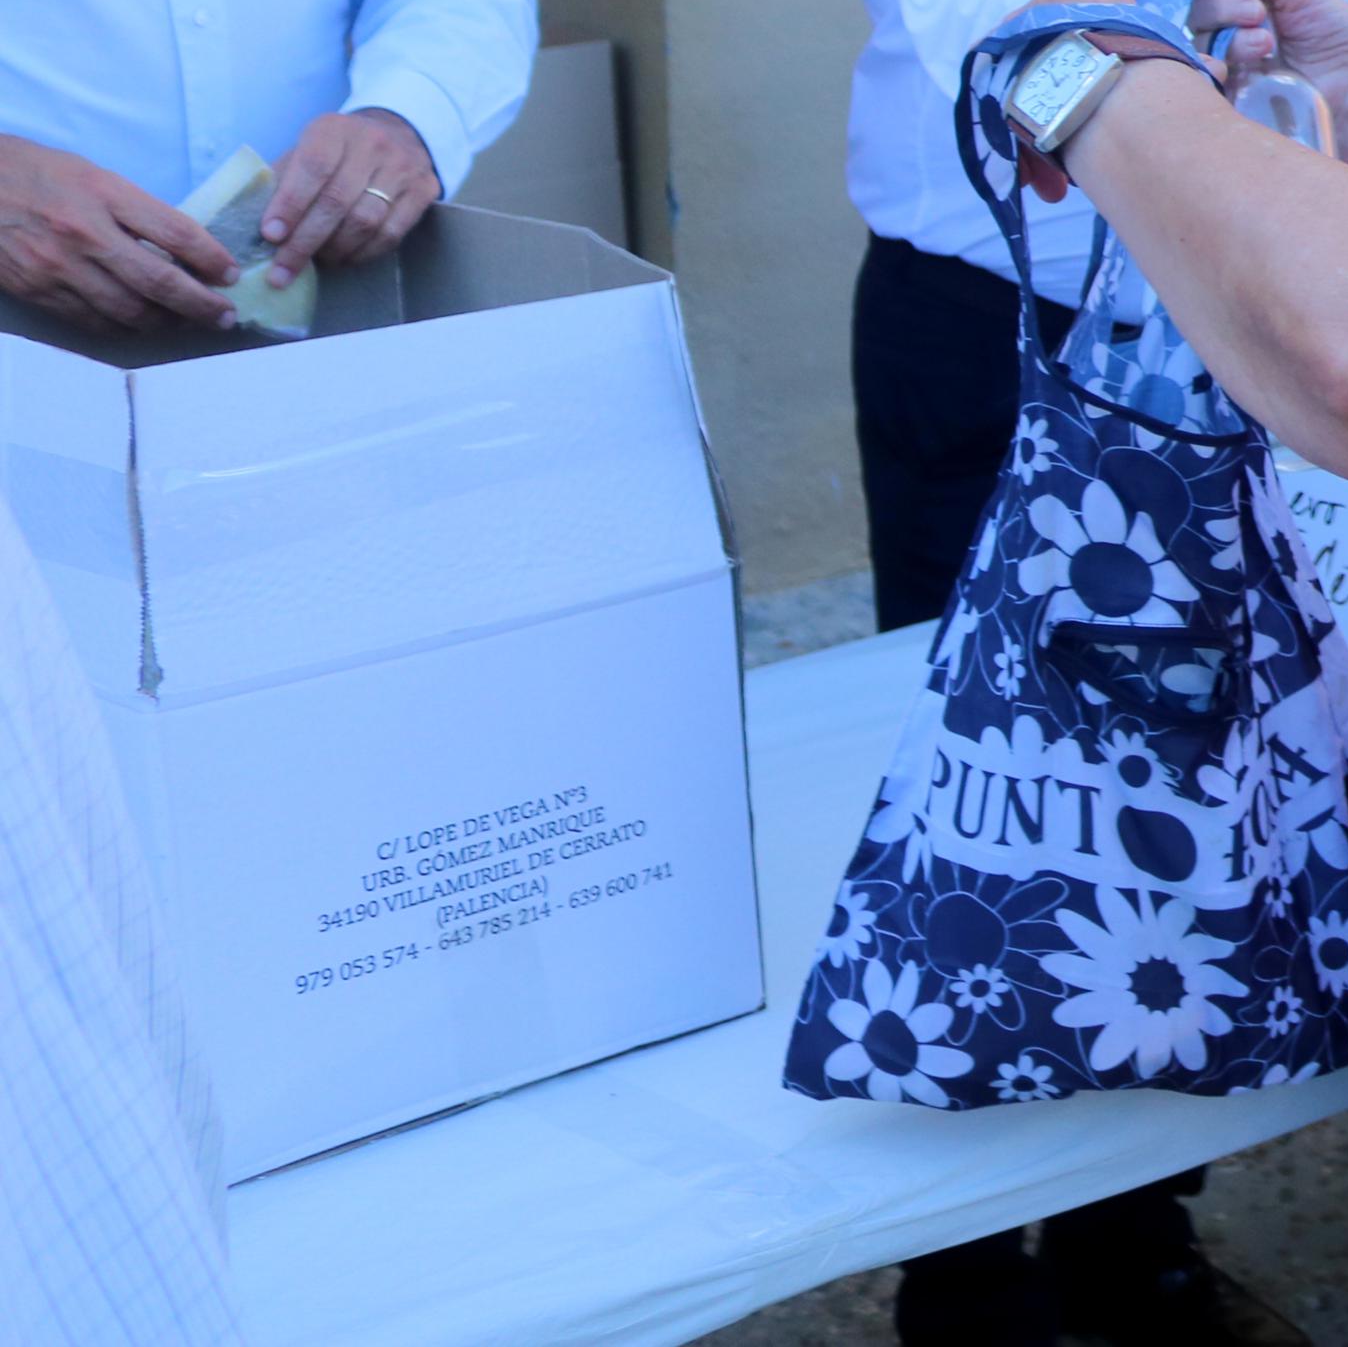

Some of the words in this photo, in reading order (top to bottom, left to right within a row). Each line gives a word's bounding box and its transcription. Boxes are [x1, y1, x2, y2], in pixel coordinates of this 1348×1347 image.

[361, 865, 412, 892] URB.
[416, 840, 493, 877] GÓMEZ
[498, 806, 606, 854] MANRIQUE
[377, 838, 399, 860] C/
[405, 823, 458, 854] LOPE
[463, 814, 491, 837] DE
[493, 798, 550, 827] VEGA
[318, 900, 380, 933] 34190
[382, 859, 524, 912] VILLAMURIEL
[528, 848, 555, 870] DE
[558, 820, 647, 860] CERRATO
[437, 876, 548, 929] (PALENCIA)
[295, 967, 334, 995] 979
[339, 955, 377, 981] 053
[382, 943, 419, 969] 574
[438, 925, 473, 951] 643
[478, 913, 513, 939] 785
[518, 901, 552, 926] 214
[569, 884, 602, 909] 639
[606, 873, 638, 897] 600
[641, 861, 673, 886] 741
